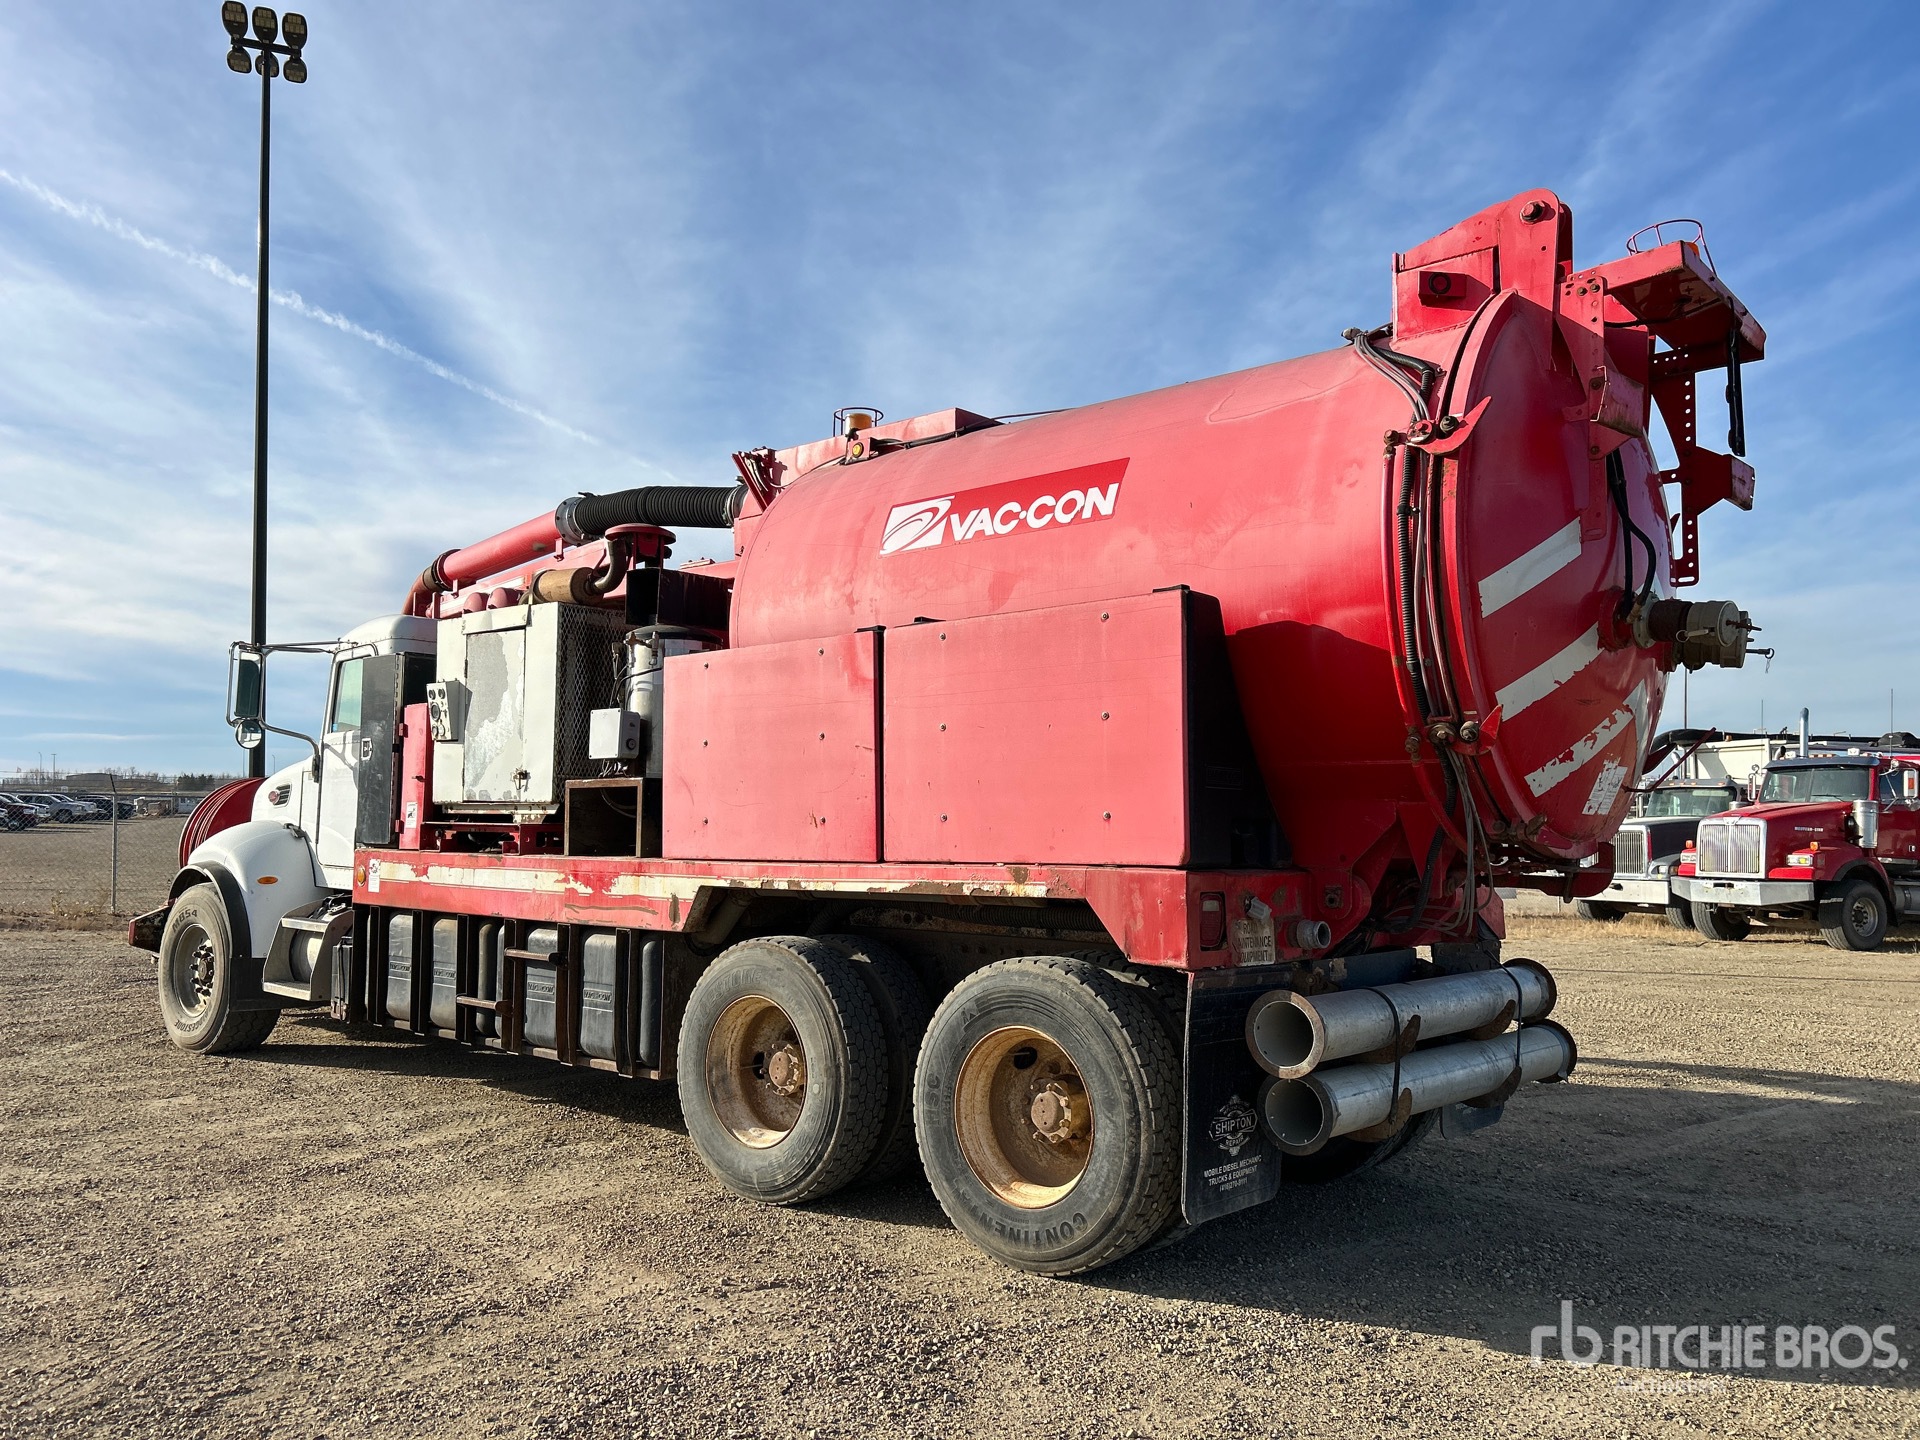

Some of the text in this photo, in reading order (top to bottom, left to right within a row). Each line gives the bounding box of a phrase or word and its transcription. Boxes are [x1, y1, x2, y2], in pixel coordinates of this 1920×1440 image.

[1215, 1116, 1252, 1135] SHIPTON
[1225, 1136, 1244, 1147] REPAIR
[1204, 1166, 1222, 1177] MOBILE
[1222, 1160, 1239, 1173] DIESEL
[1208, 1173, 1228, 1187] TRUCKS
[1232, 1164, 1258, 1179] EQUIPMENT
